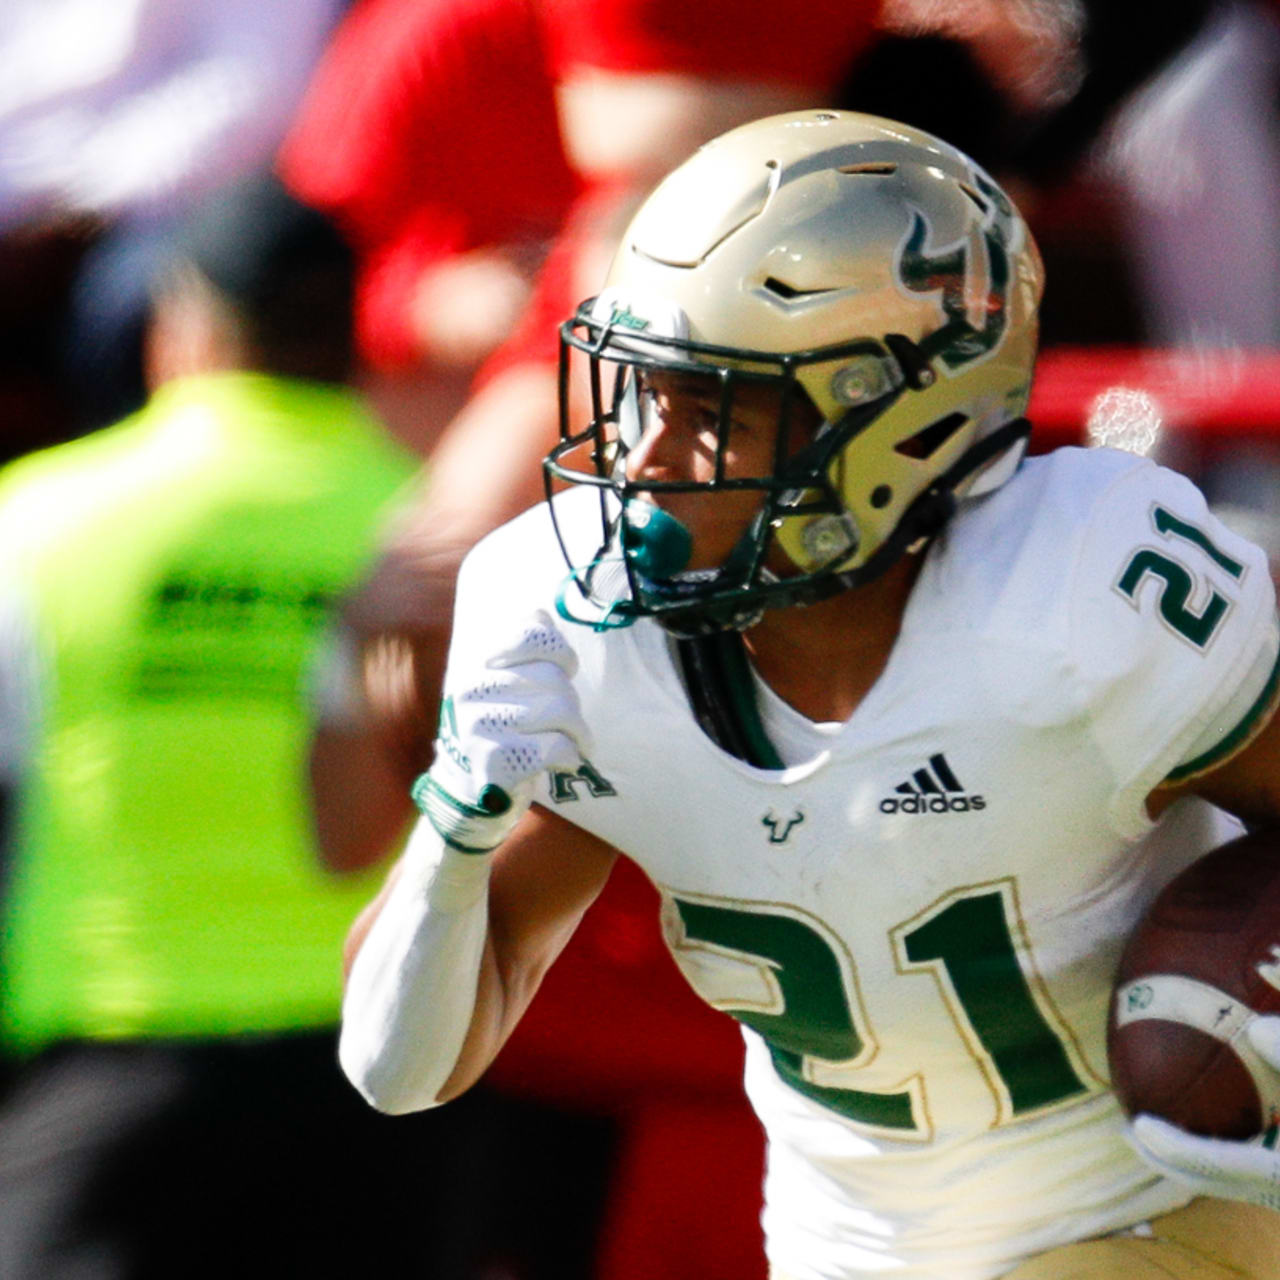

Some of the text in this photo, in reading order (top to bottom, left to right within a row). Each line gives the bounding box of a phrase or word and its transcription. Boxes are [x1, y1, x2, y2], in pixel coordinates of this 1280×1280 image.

[1111, 502, 1249, 658] 21
[879, 792, 987, 814] adidas
[658, 873, 1113, 1143] 21
